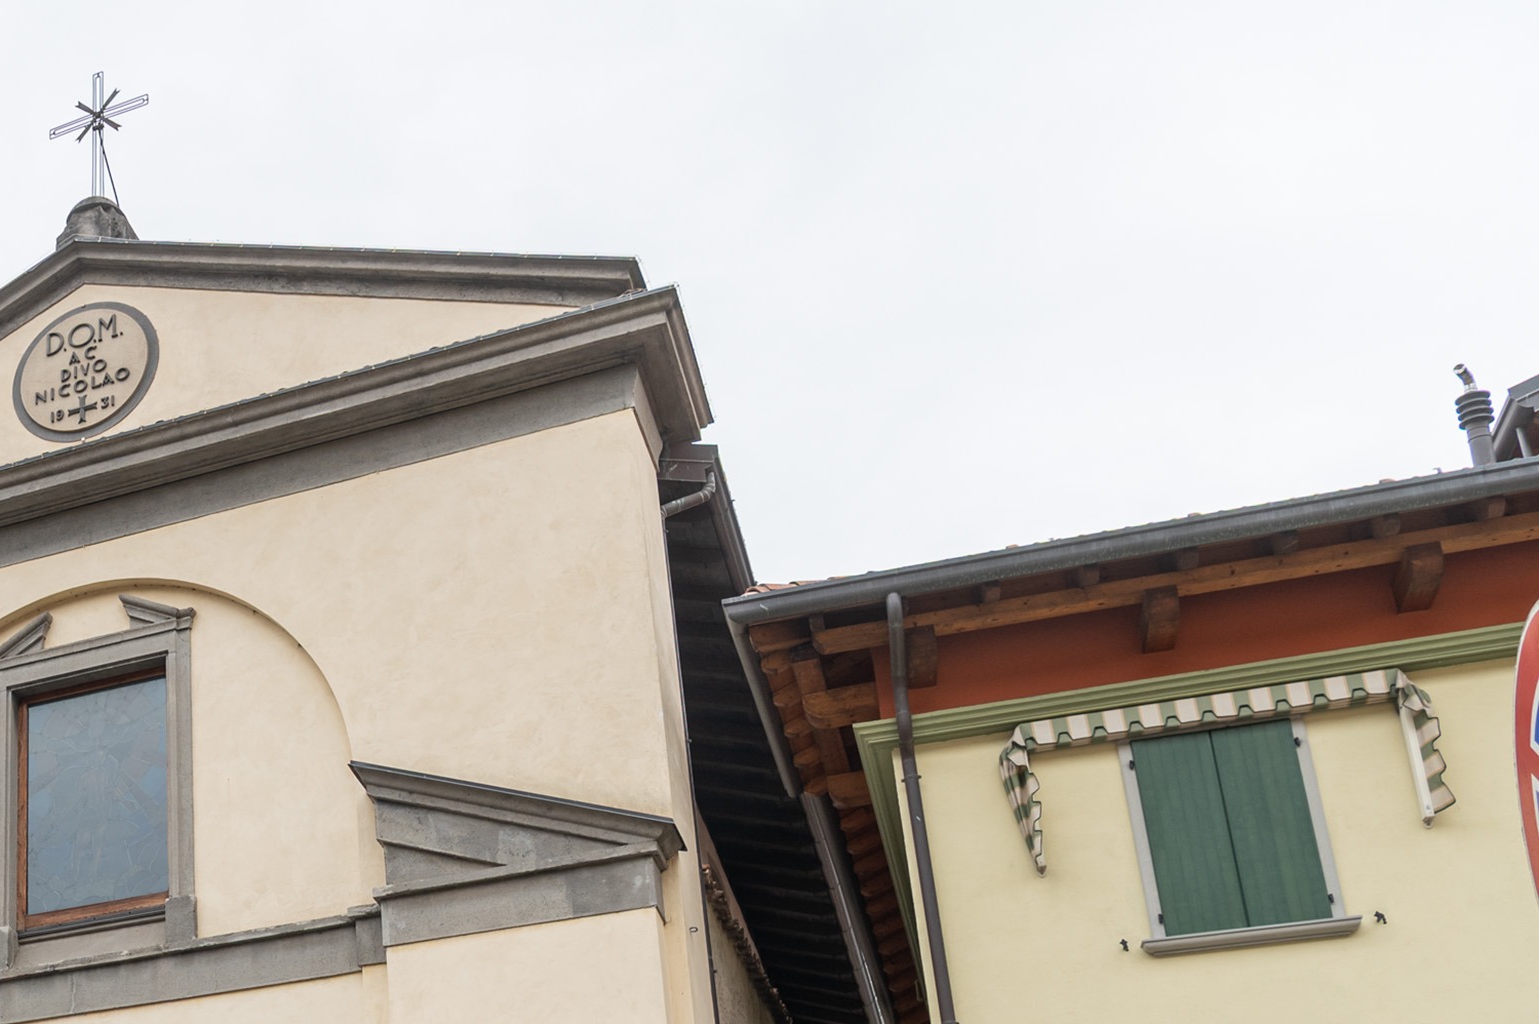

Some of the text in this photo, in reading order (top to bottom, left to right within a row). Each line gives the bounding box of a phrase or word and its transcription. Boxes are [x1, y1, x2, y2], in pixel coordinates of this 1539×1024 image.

[69, 346, 97, 366] AC
[61, 359, 107, 383] DIVO
[35, 367, 130, 405] NICOLAO
[51, 410, 65, 424] 19
